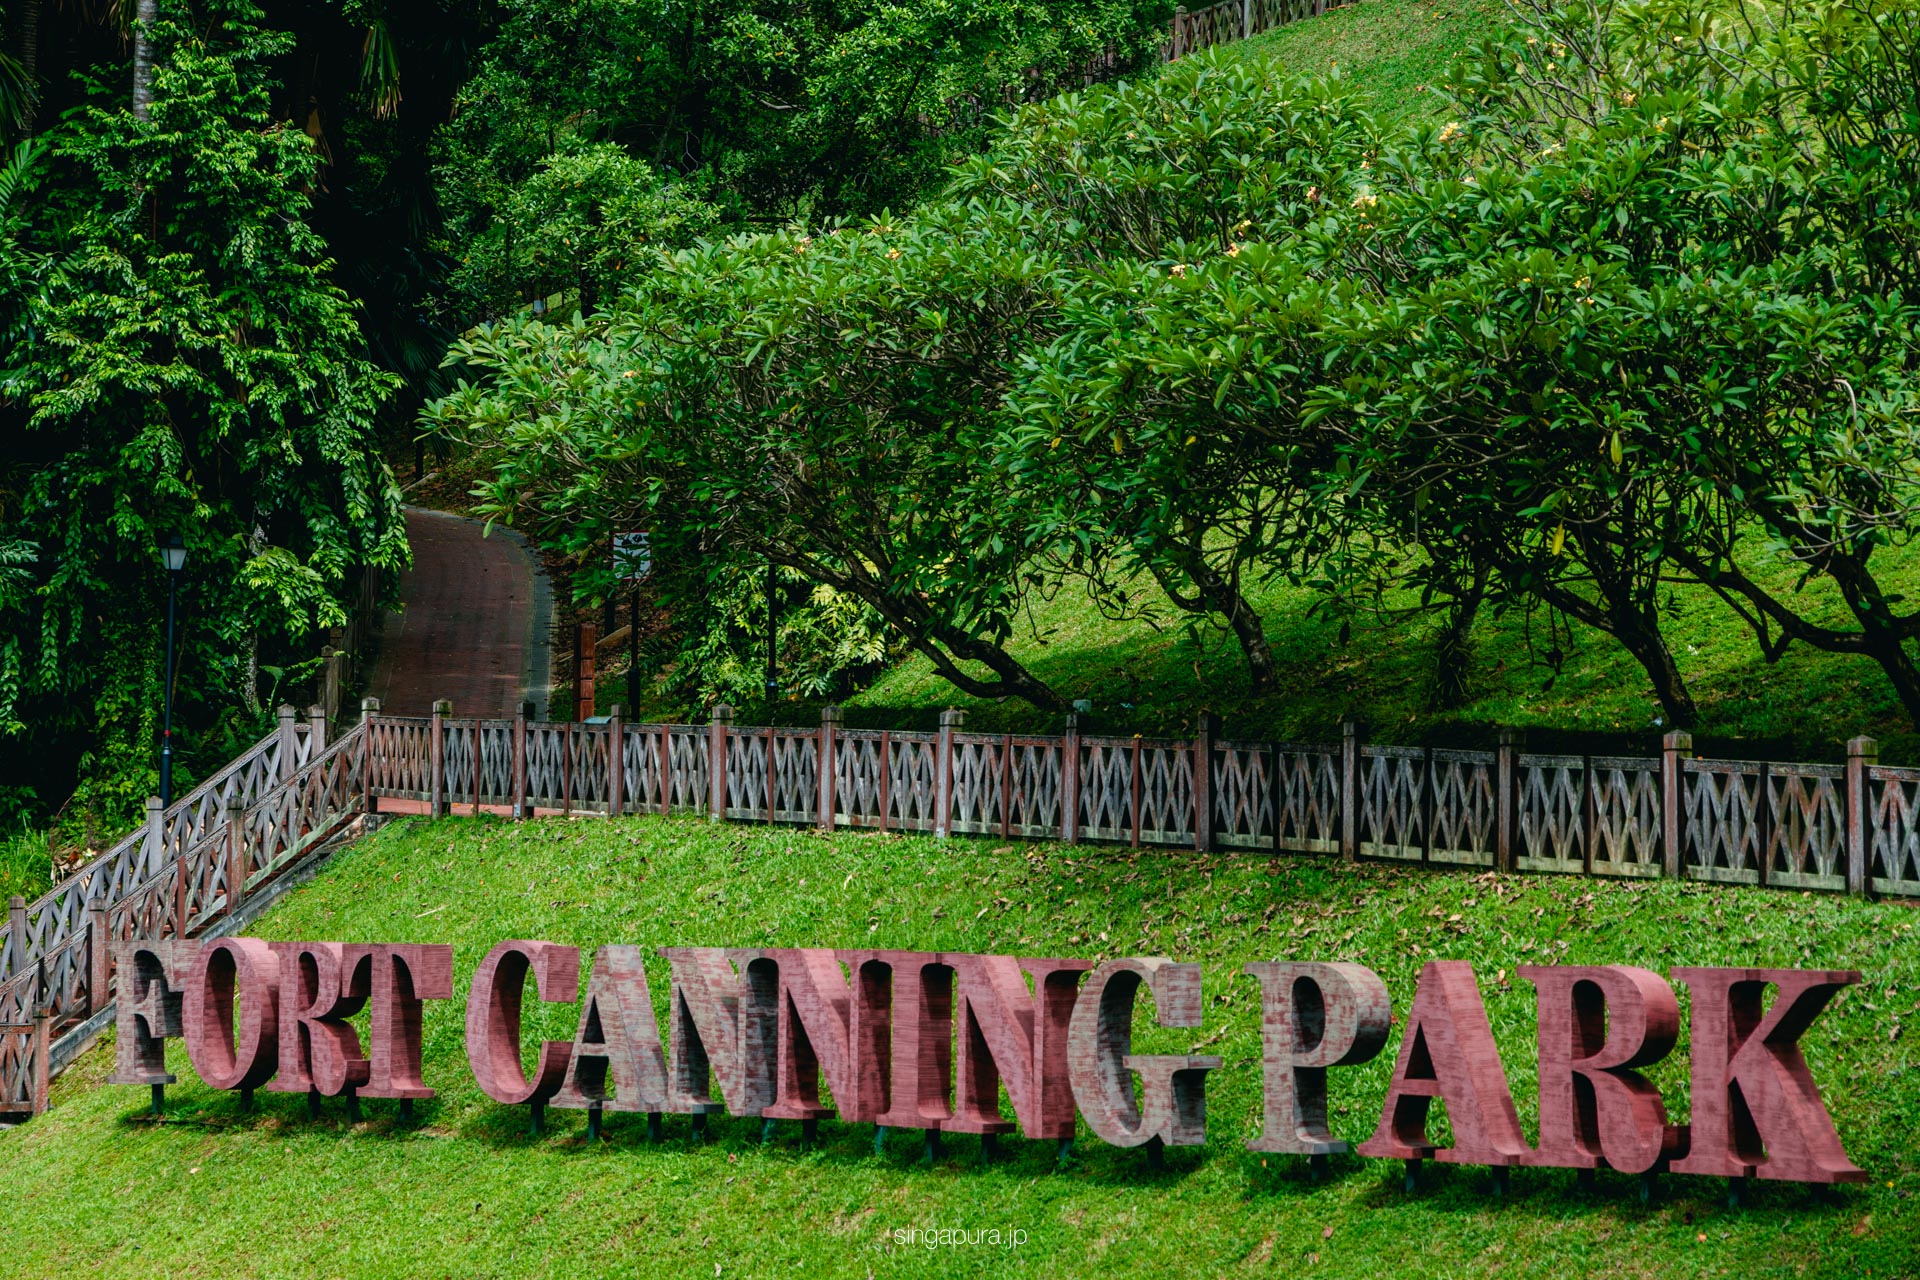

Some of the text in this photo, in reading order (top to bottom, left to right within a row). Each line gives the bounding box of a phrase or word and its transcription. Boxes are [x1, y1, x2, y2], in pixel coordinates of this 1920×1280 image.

[107, 937, 1869, 1183] FORT CANNING PARK
